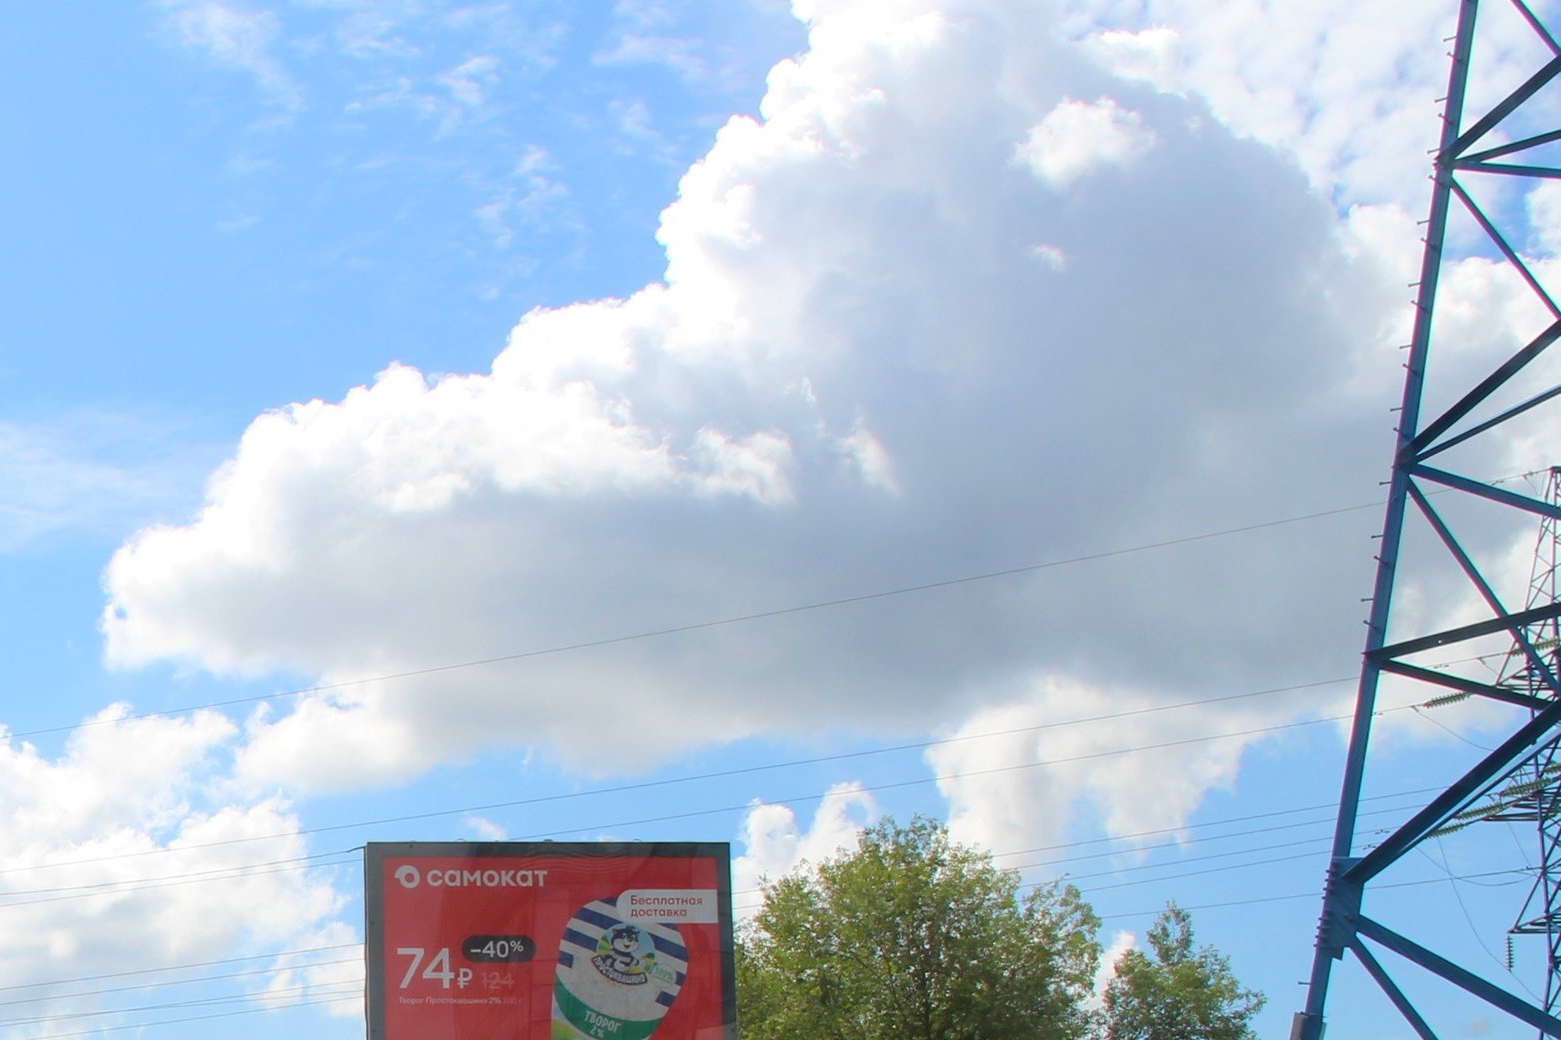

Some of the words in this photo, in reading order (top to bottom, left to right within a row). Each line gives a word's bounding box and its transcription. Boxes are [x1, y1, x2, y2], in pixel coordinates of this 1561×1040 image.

[427, 869, 548, 887] самокат
[630, 895, 703, 906] Бесплатная
[630, 908, 688, 918] доставка
[584, 1010, 622, 1034] ТВОРОГ
